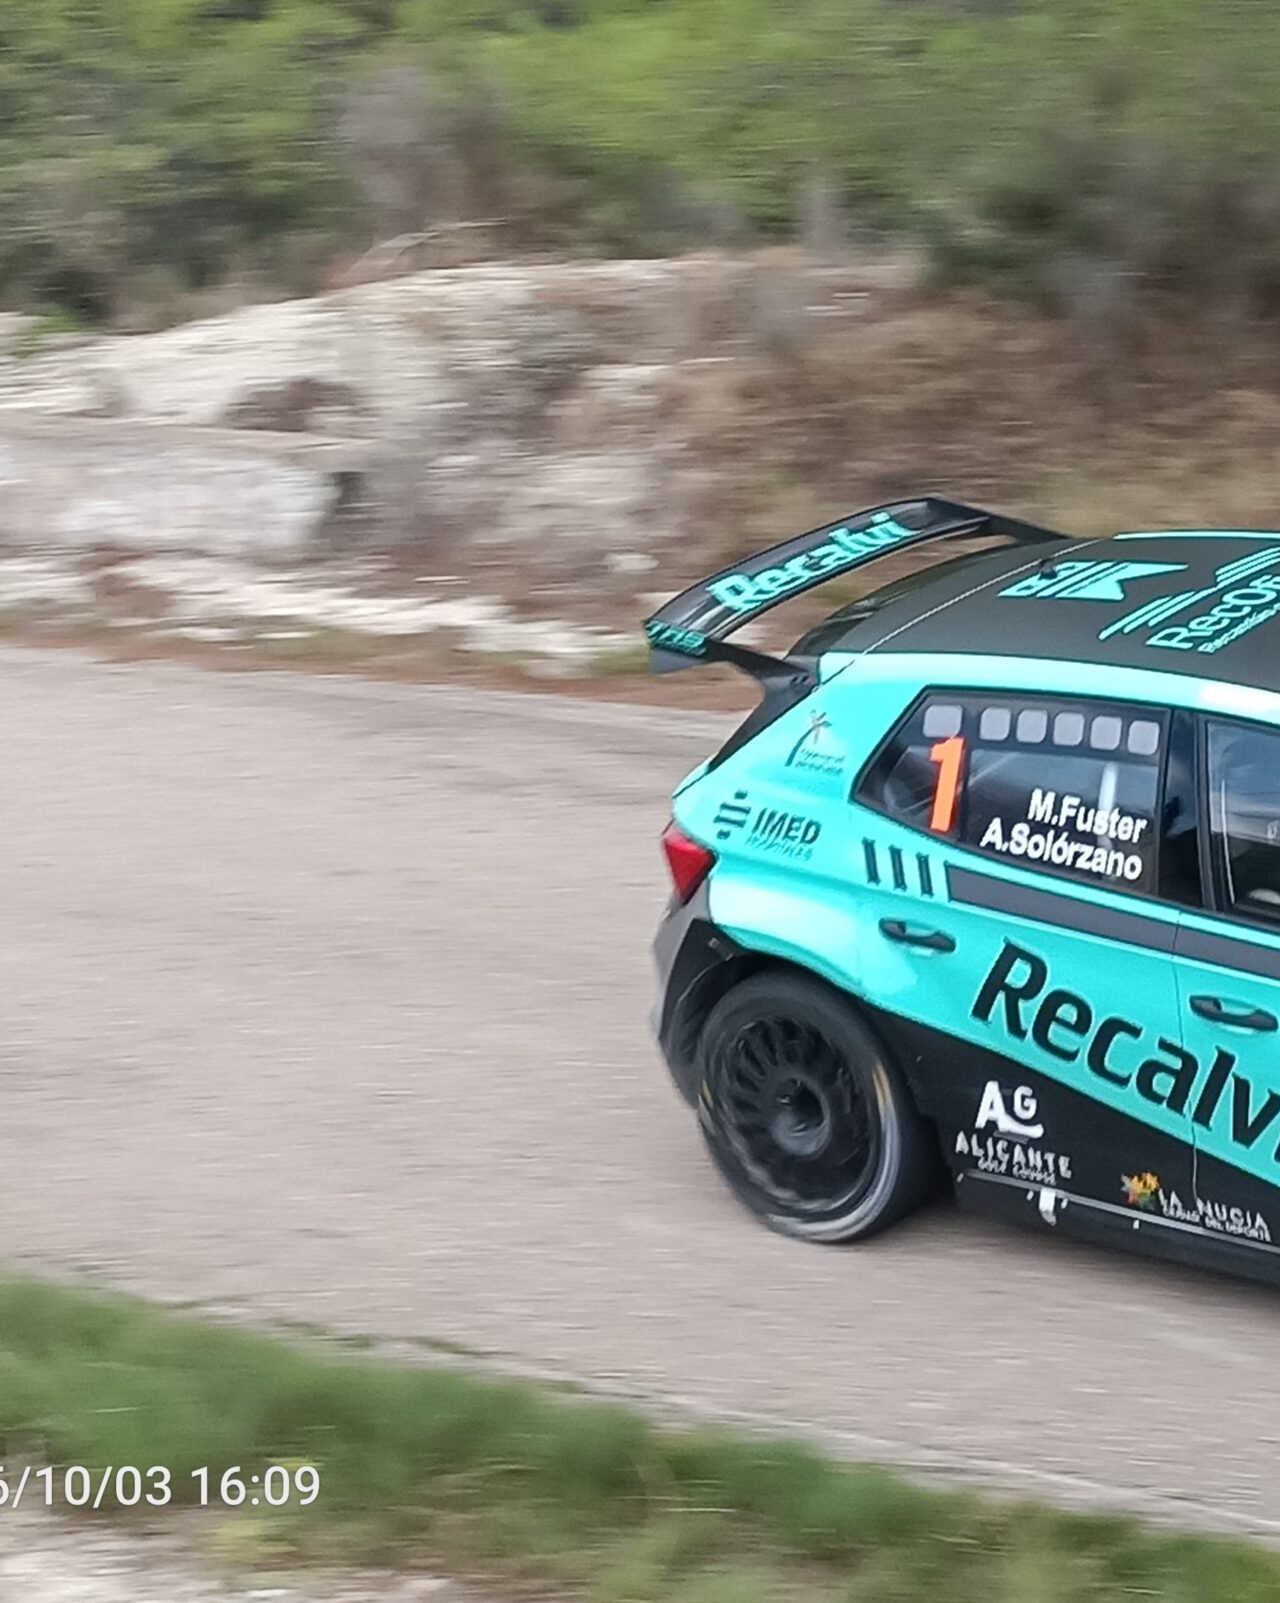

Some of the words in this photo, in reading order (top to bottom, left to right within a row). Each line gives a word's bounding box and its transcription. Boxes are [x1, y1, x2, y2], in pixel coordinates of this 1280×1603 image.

[705, 511, 923, 613] Recalvi
[929, 735, 967, 833] 1
[752, 808, 822, 844] IMED
[1028, 788, 1148, 843] M.Fuster
[979, 817, 1143, 881] A.Solórzano
[955, 1131, 1072, 1179] ALICANTE
